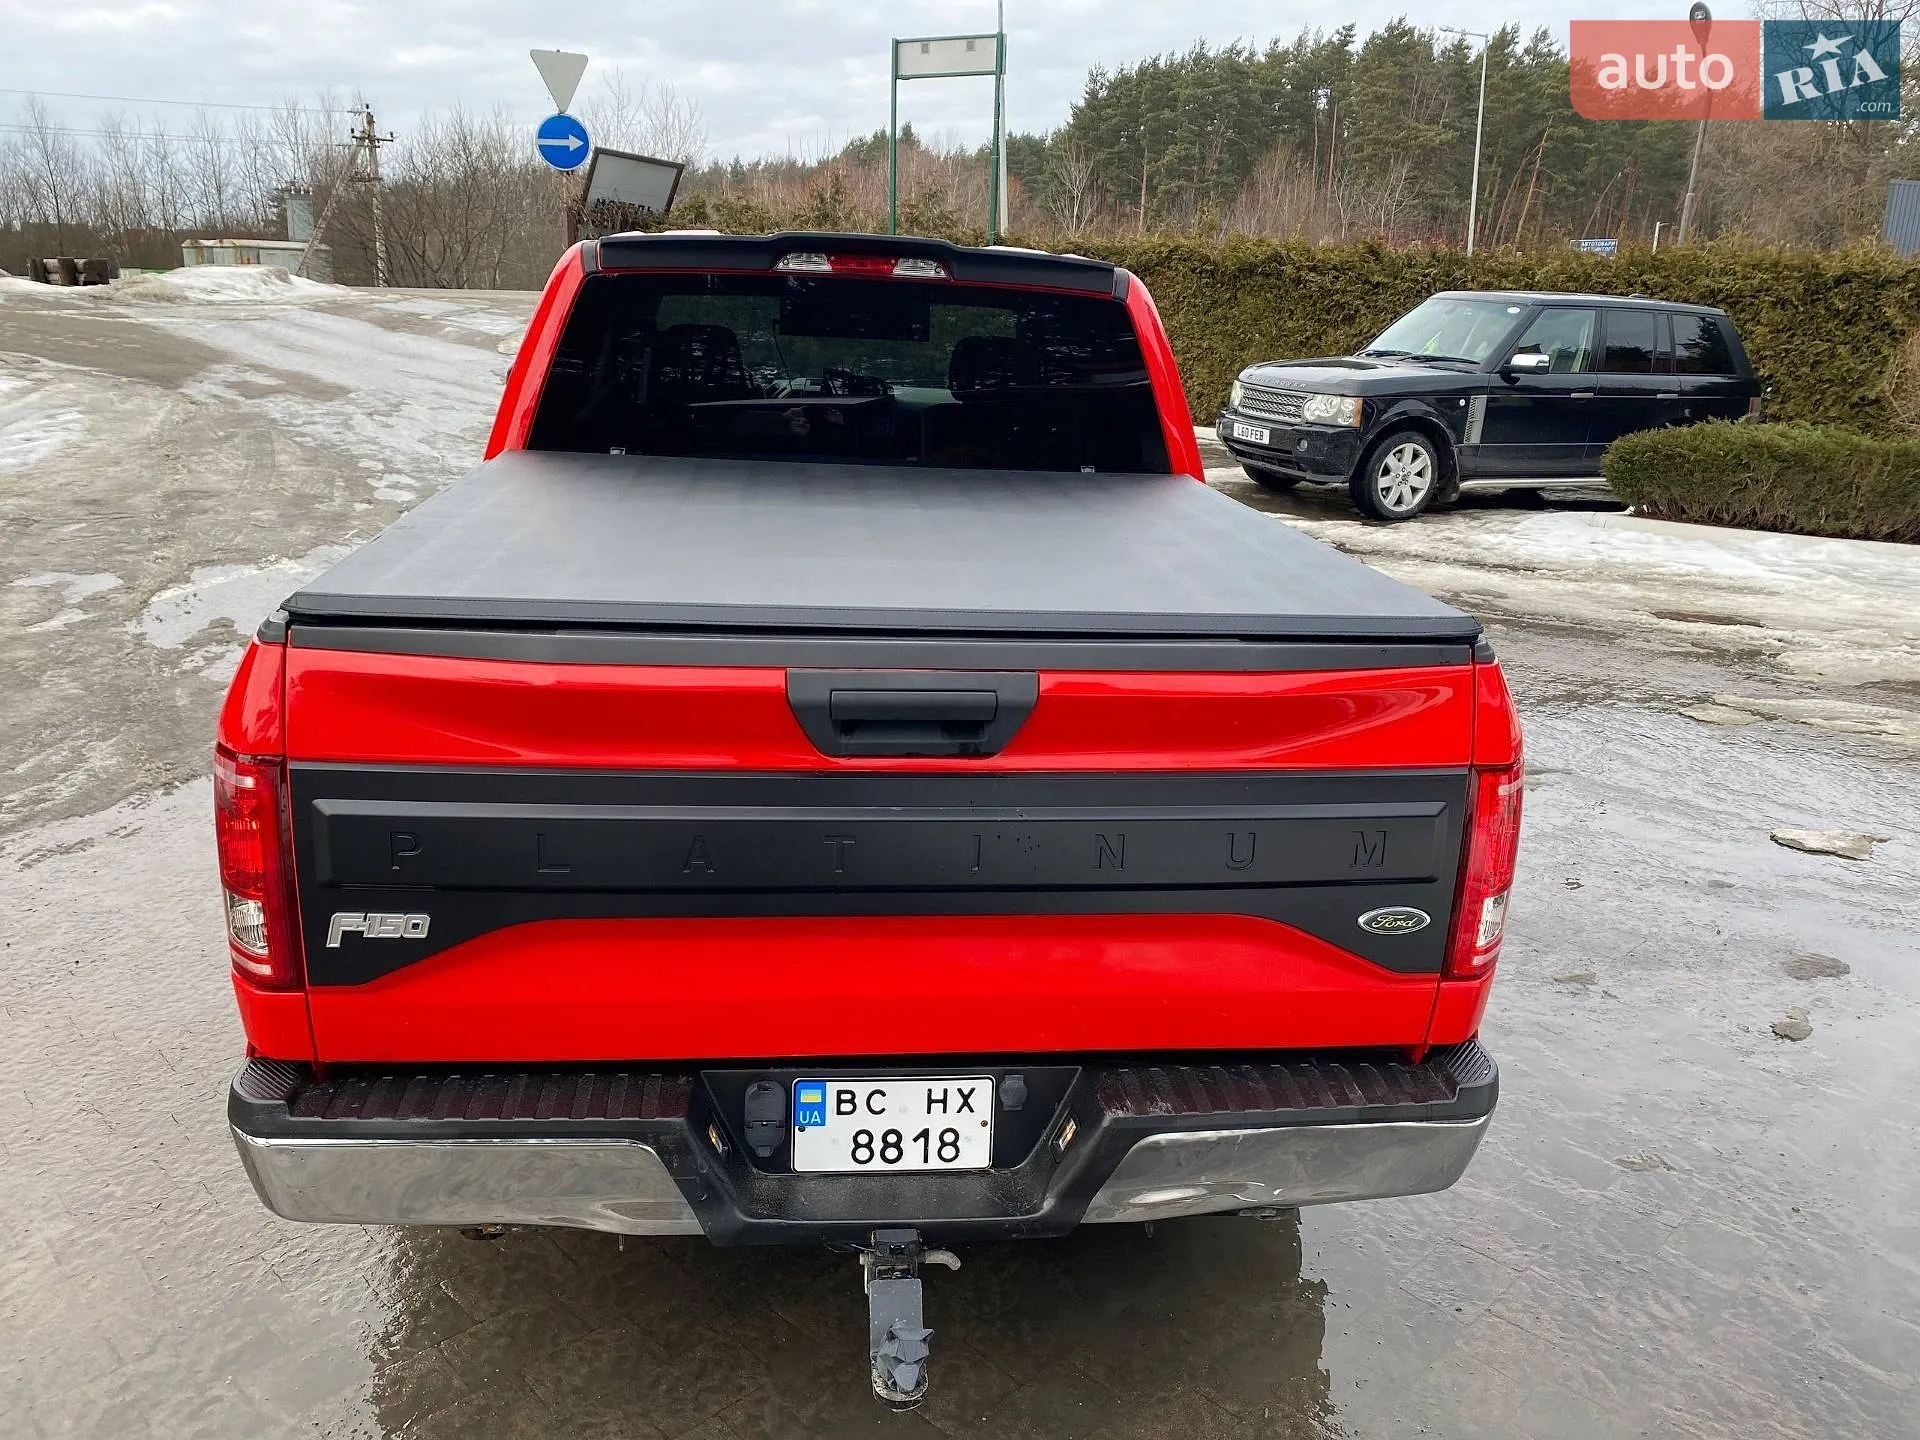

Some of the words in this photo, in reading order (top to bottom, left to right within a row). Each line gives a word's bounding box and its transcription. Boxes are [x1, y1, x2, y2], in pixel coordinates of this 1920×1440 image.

[326, 912, 431, 948] F-150
[1372, 914, 1418, 928] Ford
[836, 1089, 887, 1116] BC
[926, 1087, 976, 1115] HX
[799, 1110, 821, 1124] UA
[851, 1127, 960, 1165] 8818
